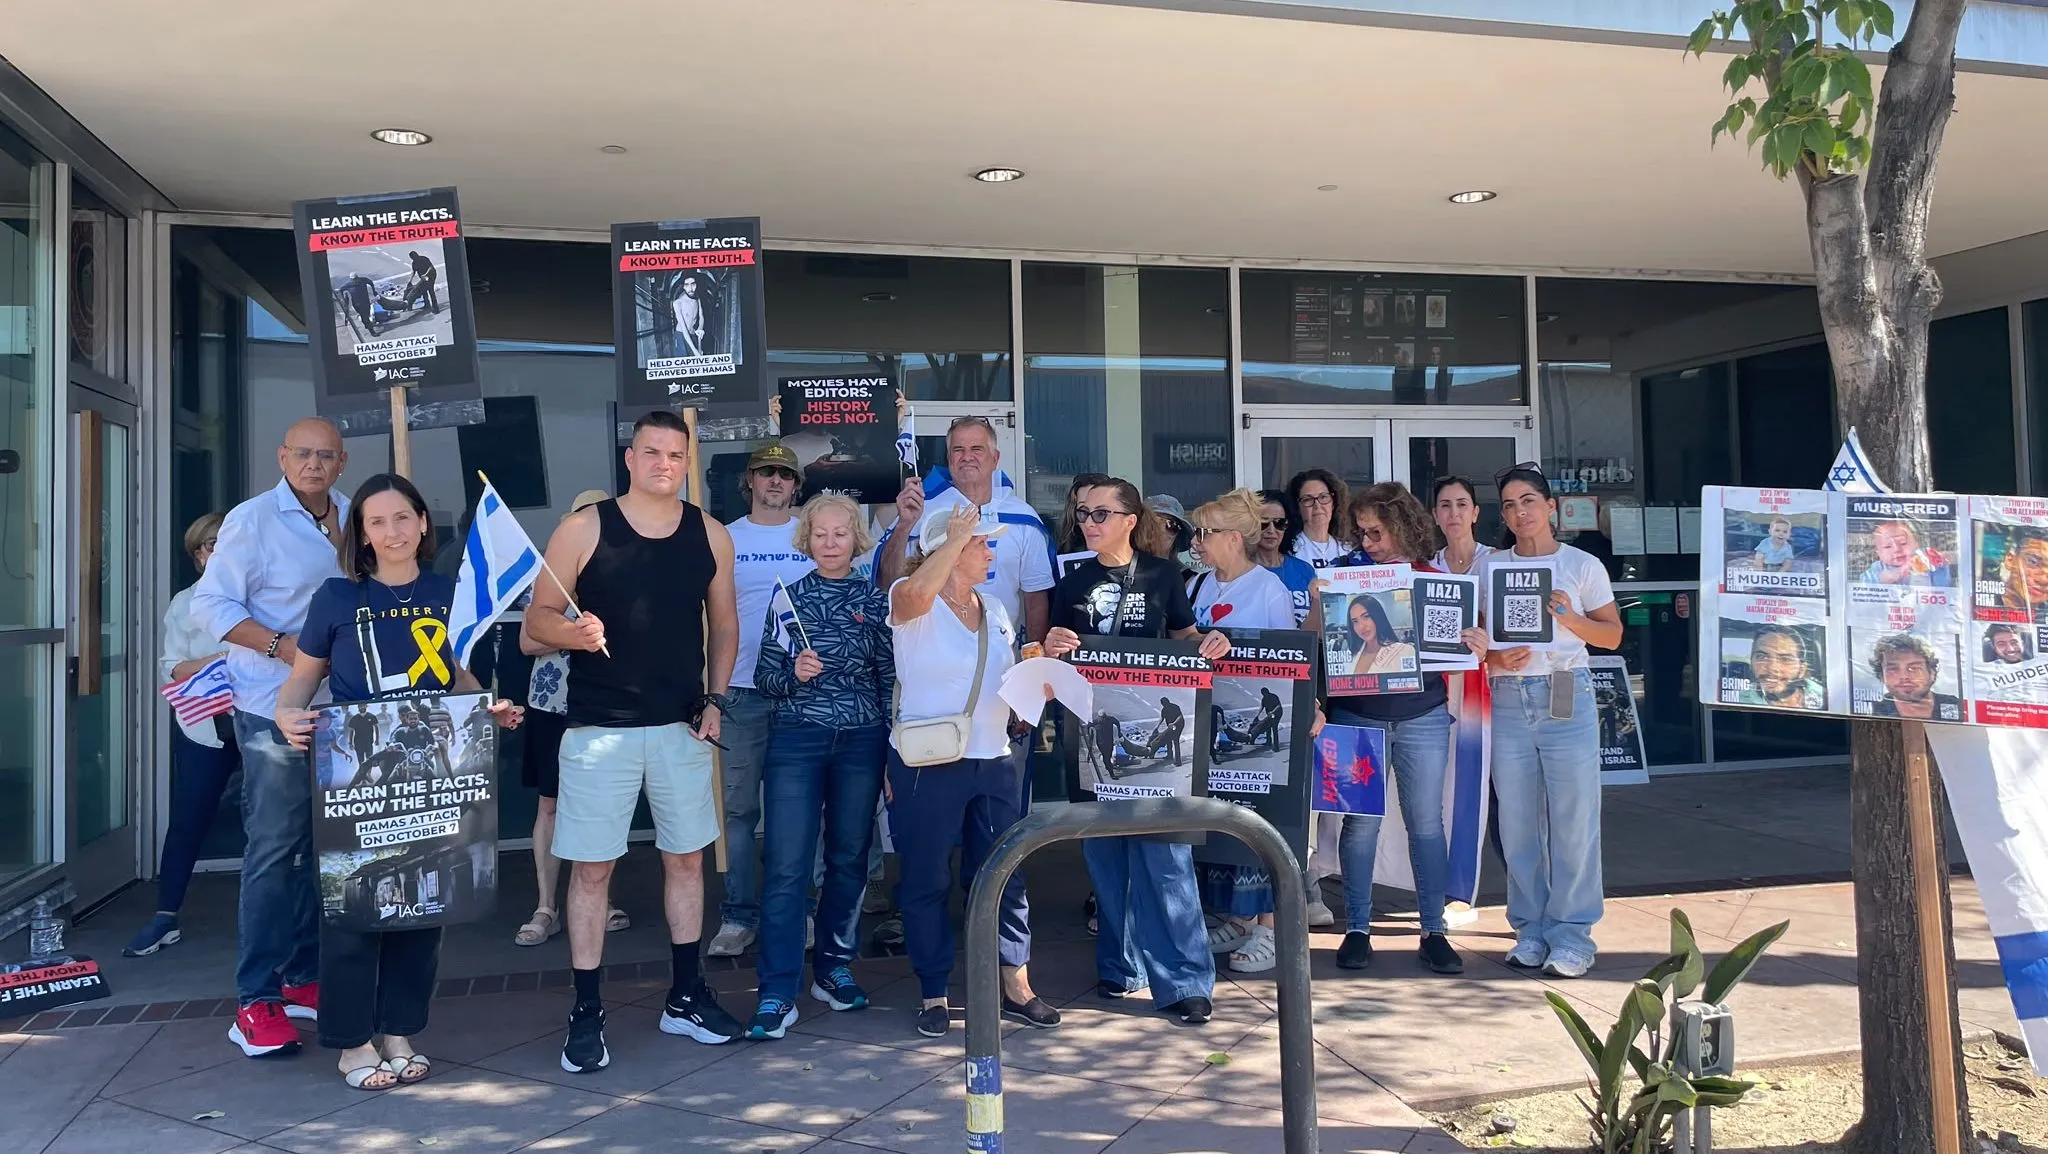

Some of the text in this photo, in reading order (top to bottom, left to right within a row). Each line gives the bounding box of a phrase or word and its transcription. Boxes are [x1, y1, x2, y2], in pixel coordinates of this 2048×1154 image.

[312, 208, 452, 230] LEARN THE FACTS.
[320, 227, 448, 246] KNOW THE TRUTH.
[625, 237, 751, 252] LEARN THE FACTS.
[630, 254, 746, 266] KNOW THE TRUTH.
[356, 336, 435, 352] HAMAS ATTACK
[361, 355, 376, 363] ON
[378, 349, 426, 361] OCTOBER
[675, 357, 709, 366] CAPTIVE
[389, 368, 409, 379] IAC
[649, 369, 686, 377] STARVED
[703, 365, 733, 373] HAMAS
[682, 384, 699, 394] IAC
[788, 378, 888, 387] MOVIES HAVE
[805, 388, 872, 398] EDITORS.
[808, 401, 871, 412] HISTORY
[800, 412, 879, 424] DOES NOT.
[834, 488, 849, 497] IAC
[1854, 502, 1949, 515] MURDERED
[751, 553, 789, 561] ישראל
[792, 553, 808, 562] עם
[1349, 571, 1370, 579] ESTHER
[1505, 572, 1540, 588] NAZA
[1738, 574, 1818, 587] MURDERED
[1426, 583, 1461, 599] NAZA
[1976, 581, 2005, 594] BRING
[1126, 593, 1145, 601] אם
[1921, 596, 1946, 605] 503
[1976, 594, 1995, 607] HIM
[441, 607, 448, 615] 7
[1071, 650, 1120, 664] LEARN
[1124, 653, 1154, 666] THE
[1158, 656, 1210, 669] FACTS.
[1230, 647, 1307, 660] THE FACTS.
[1327, 650, 1352, 663] BRING
[1228, 664, 1252, 674] THE
[1256, 666, 1300, 677] TRUTH.
[1328, 663, 1344, 675] HER
[1076, 668, 1203, 686] KNOW THE TRUTH.
[1329, 677, 1352, 690] HOME
[1354, 674, 1379, 688] NOW!
[1722, 678, 1750, 690] BRING
[1722, 690, 1739, 702] HIM
[1854, 688, 1882, 702] BRING
[1854, 702, 1873, 714] HIM
[1605, 756, 1637, 764] ISRAEL
[1209, 771, 1270, 780] AMAS ATTACK
[1323, 738, 1337, 803] HATRED
[325, 773, 490, 804] LEARN THE FACTS.
[1096, 785, 1173, 797] HAMAS ATTACK
[1215, 782, 1260, 792] OCTOBER
[324, 788, 491, 818] KNOW THE TRUTH.
[359, 809, 459, 833] HAMAS ATTACK
[363, 823, 456, 846] ON OCTOBER 7
[398, 903, 423, 918] IAC
[9, 972, 40, 982] THE
[44, 964, 88, 978] KNOW
[50, 975, 101, 992] LEARN
[14, 984, 48, 999] THE
